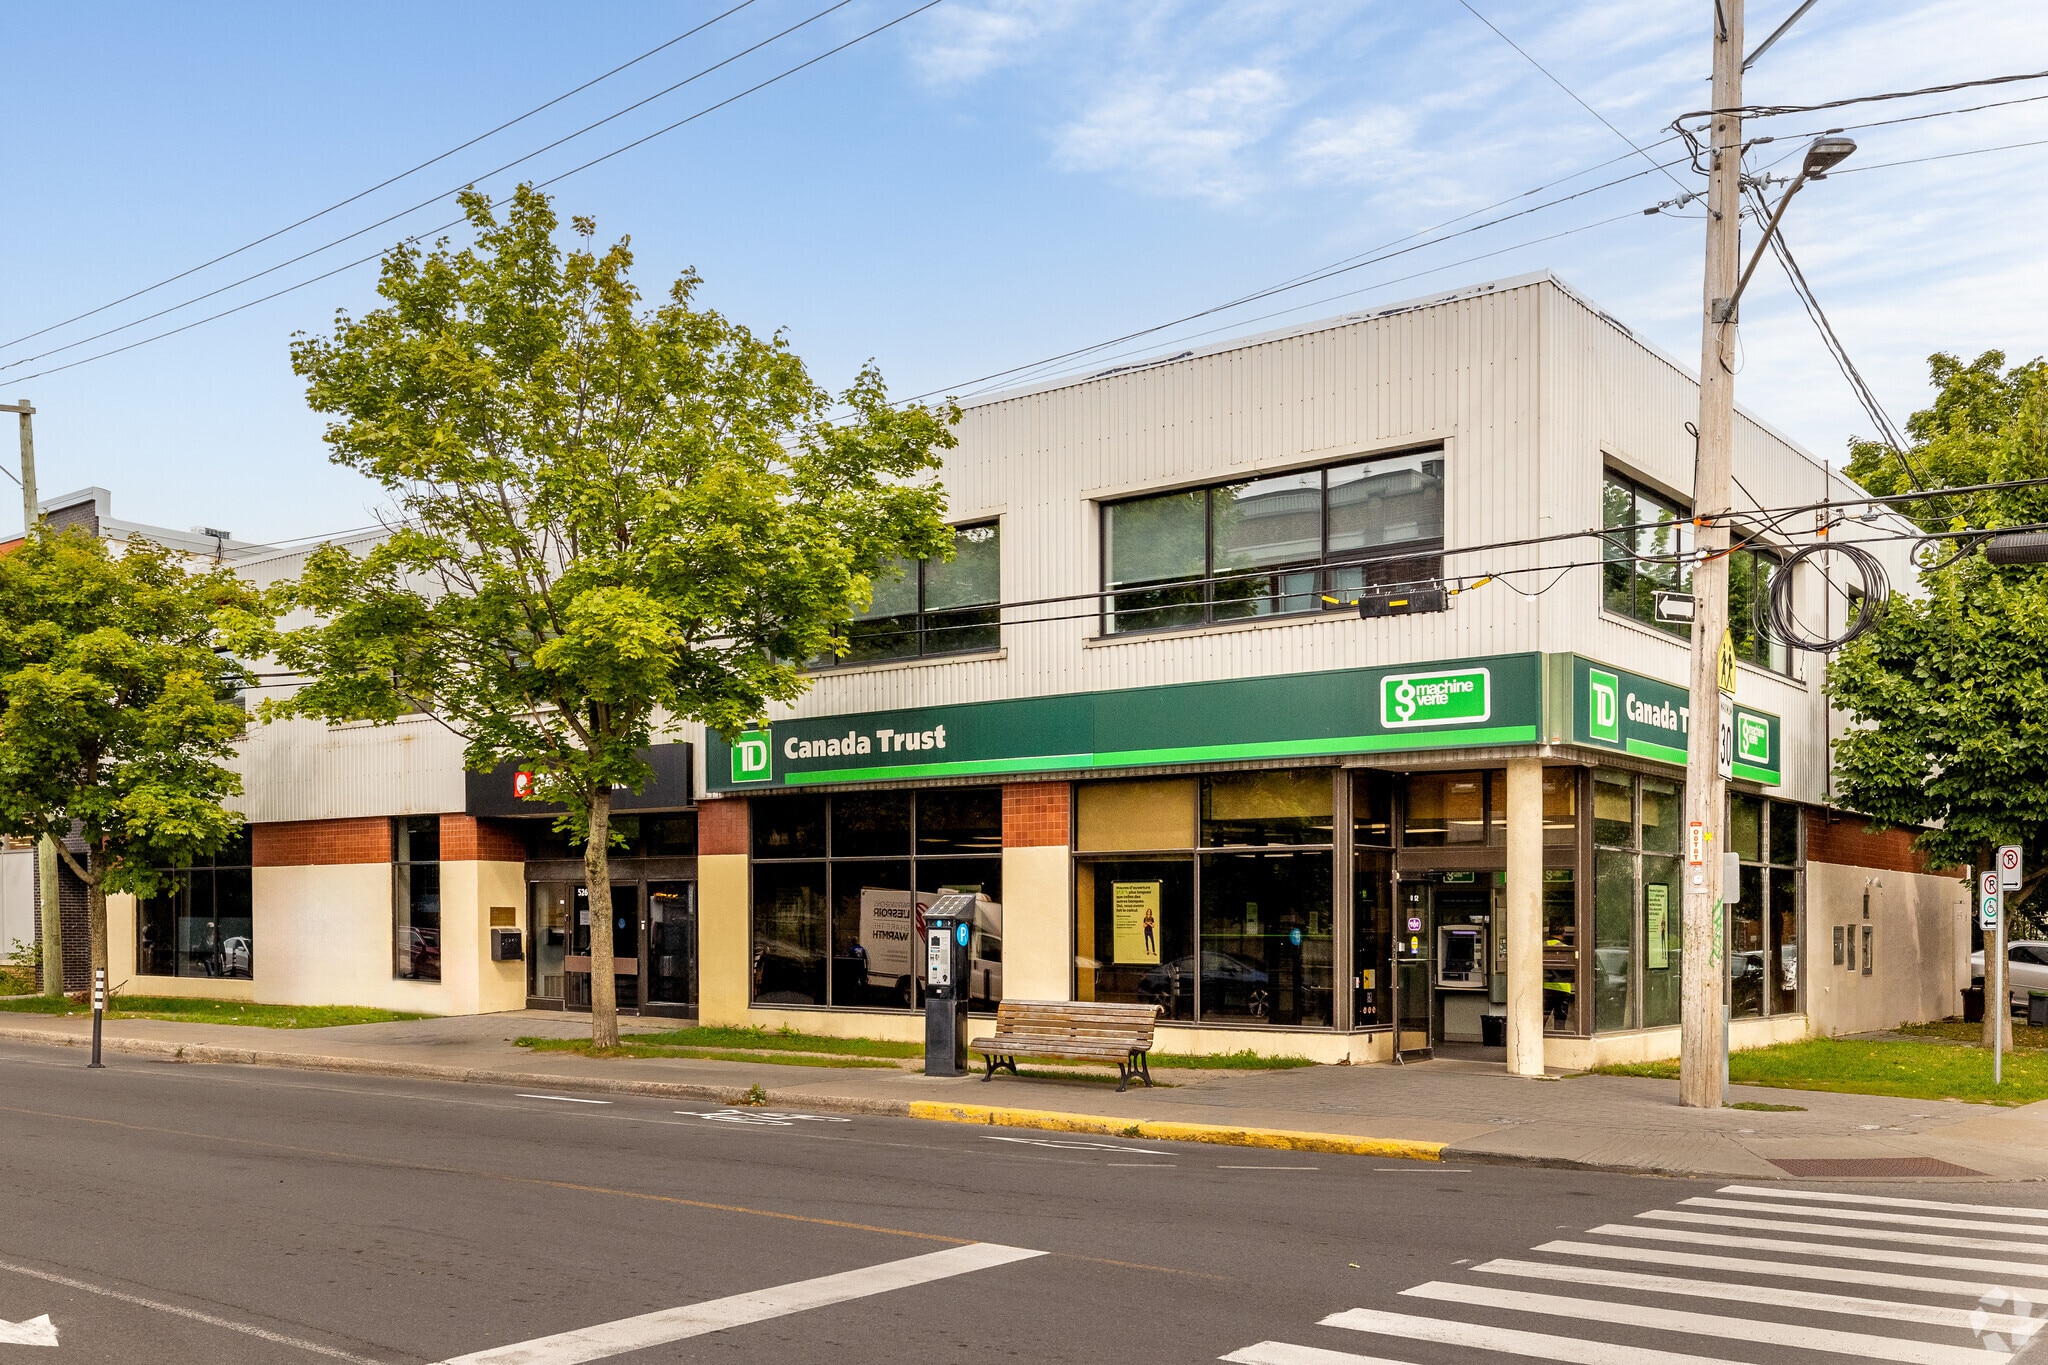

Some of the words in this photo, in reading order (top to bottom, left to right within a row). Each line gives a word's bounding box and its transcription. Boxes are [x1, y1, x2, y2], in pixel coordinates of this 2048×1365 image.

[1416, 679, 1474, 696] machine
[1416, 693, 1449, 706] verte
[1592, 682, 1616, 728] TD
[1626, 692, 1678, 731] Canada
[736, 740, 768, 772] TD
[784, 730, 871, 760] Canada
[876, 724, 946, 753] Trust
[1720, 723, 1732, 767] 30
[960, 926, 967, 942] P
